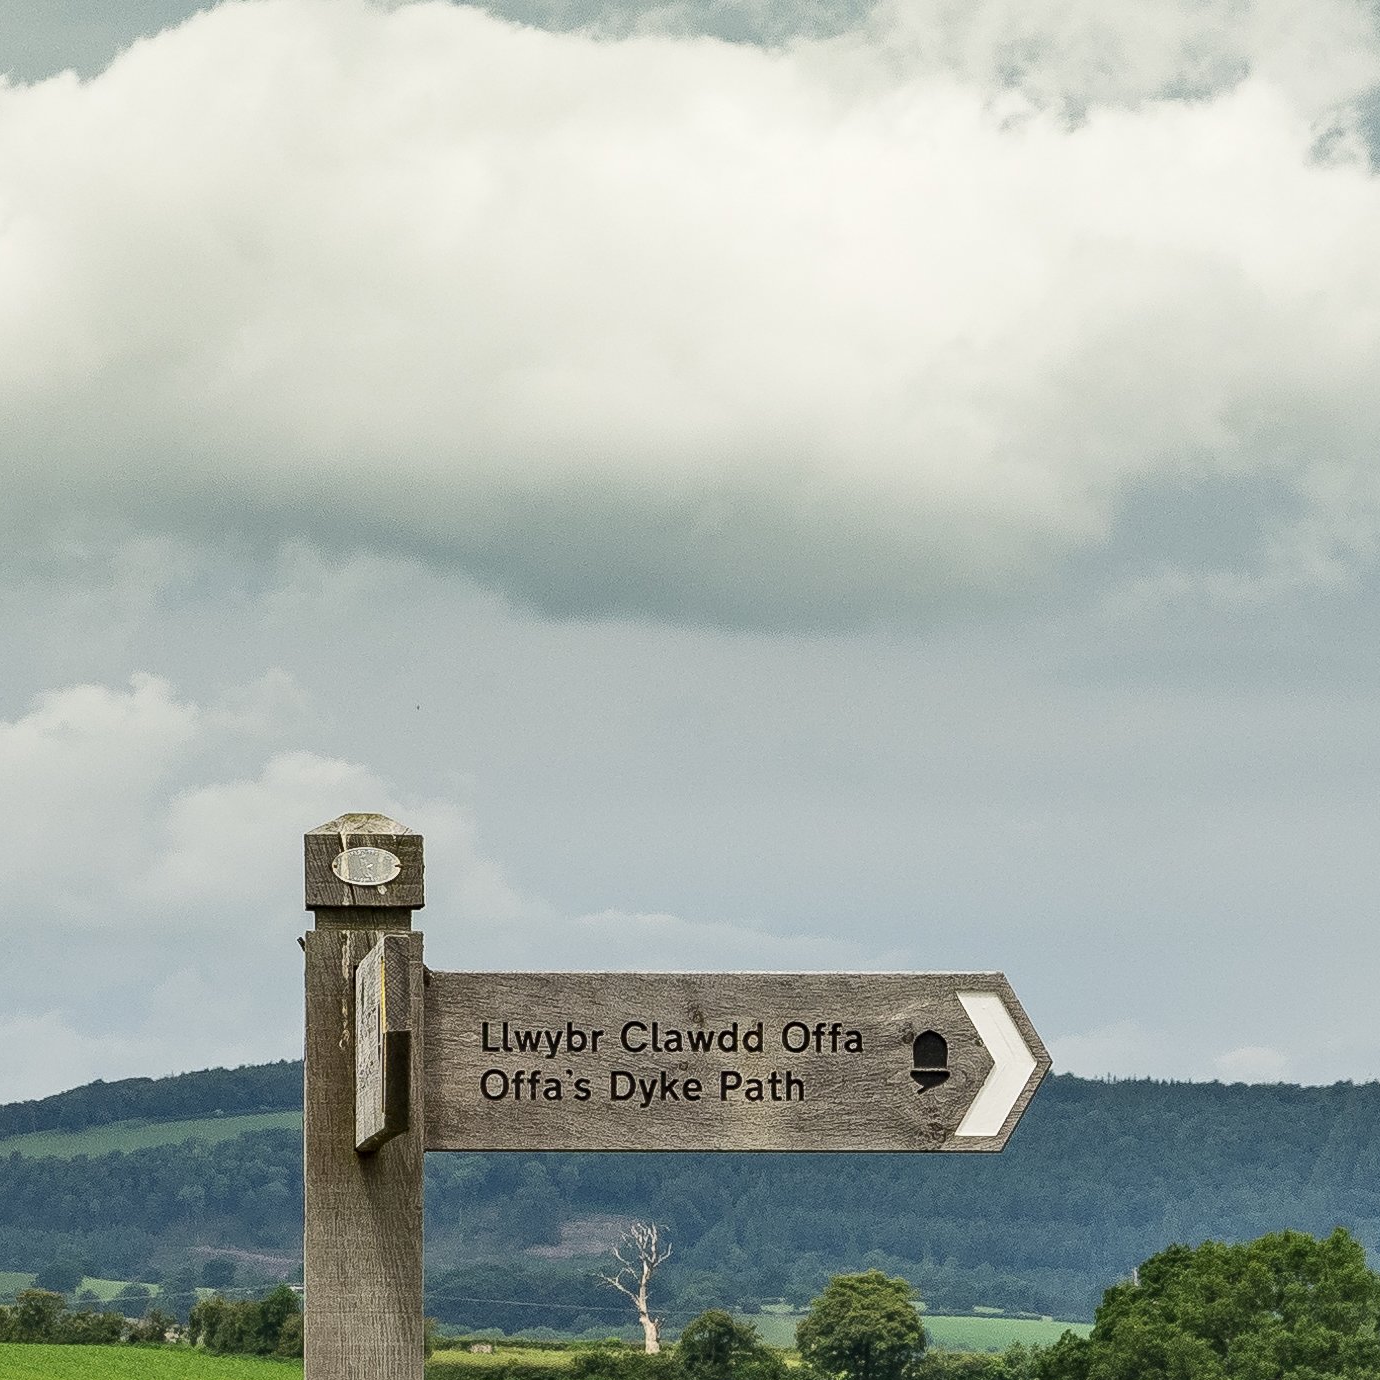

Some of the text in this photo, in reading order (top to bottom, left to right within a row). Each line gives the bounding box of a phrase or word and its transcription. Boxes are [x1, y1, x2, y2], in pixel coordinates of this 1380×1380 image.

[482, 1021, 864, 1059] Llwybr Clawdd Offa
[480, 1069, 804, 1108] Offa's Dyke Path
